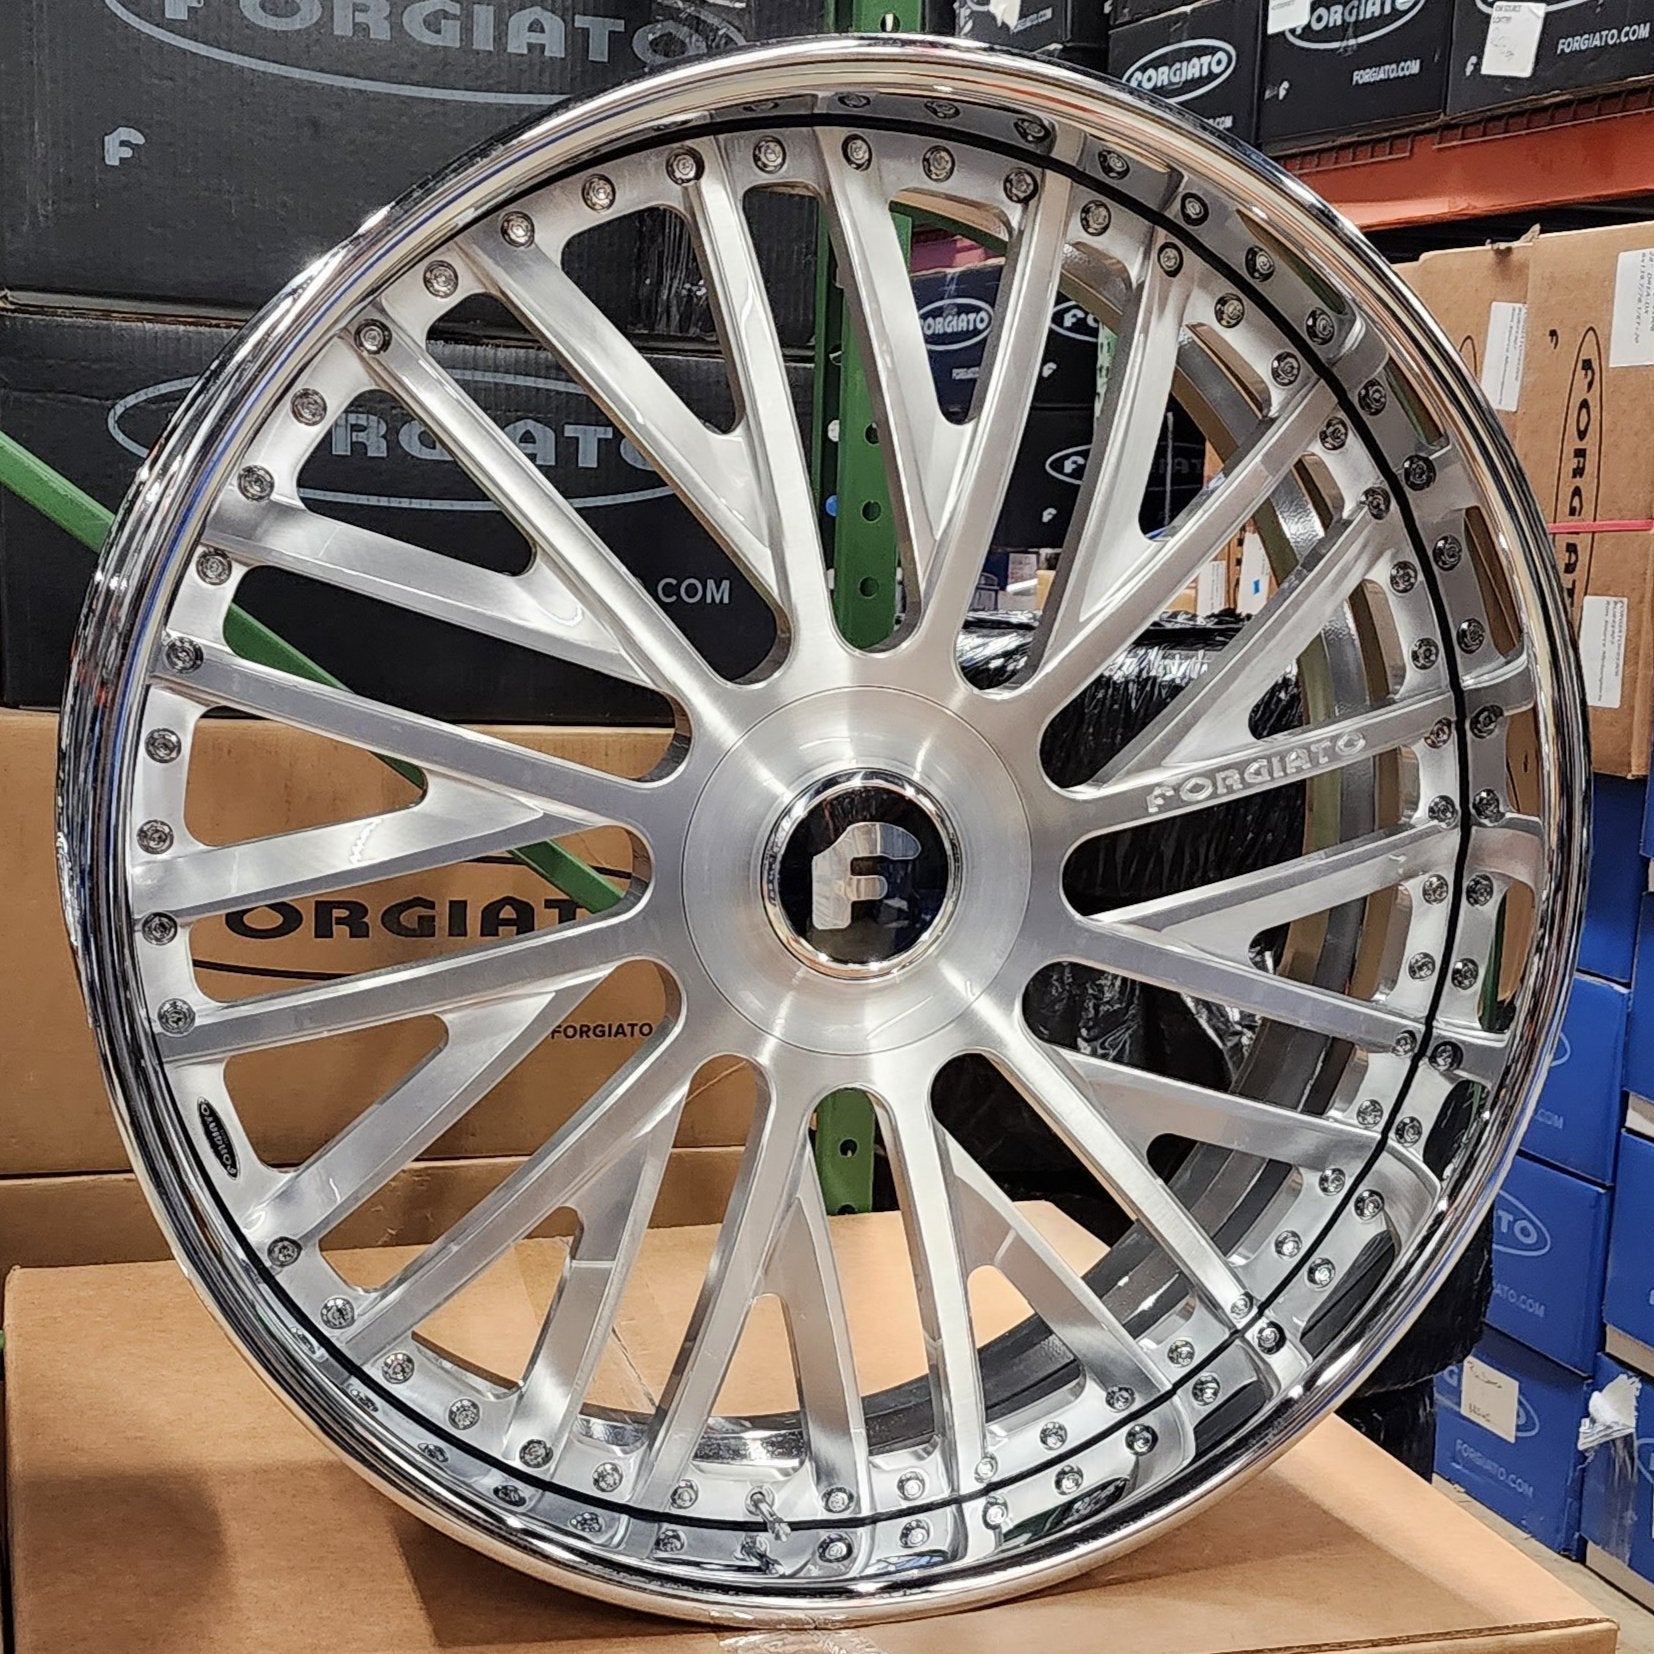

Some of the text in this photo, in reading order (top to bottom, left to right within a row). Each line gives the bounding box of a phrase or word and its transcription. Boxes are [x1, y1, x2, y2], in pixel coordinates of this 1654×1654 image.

[1557, 22, 1651, 54] FORGIATO.COM
[1130, 50, 1218, 90] FORGIATO
[1352, 59, 1420, 86] FORGIATO.COM
[104, 127, 146, 166] F
[1147, 729, 1366, 812] FORGIATO
[812, 821, 922, 930] F
[551, 1022, 654, 1040] FORGIATO
